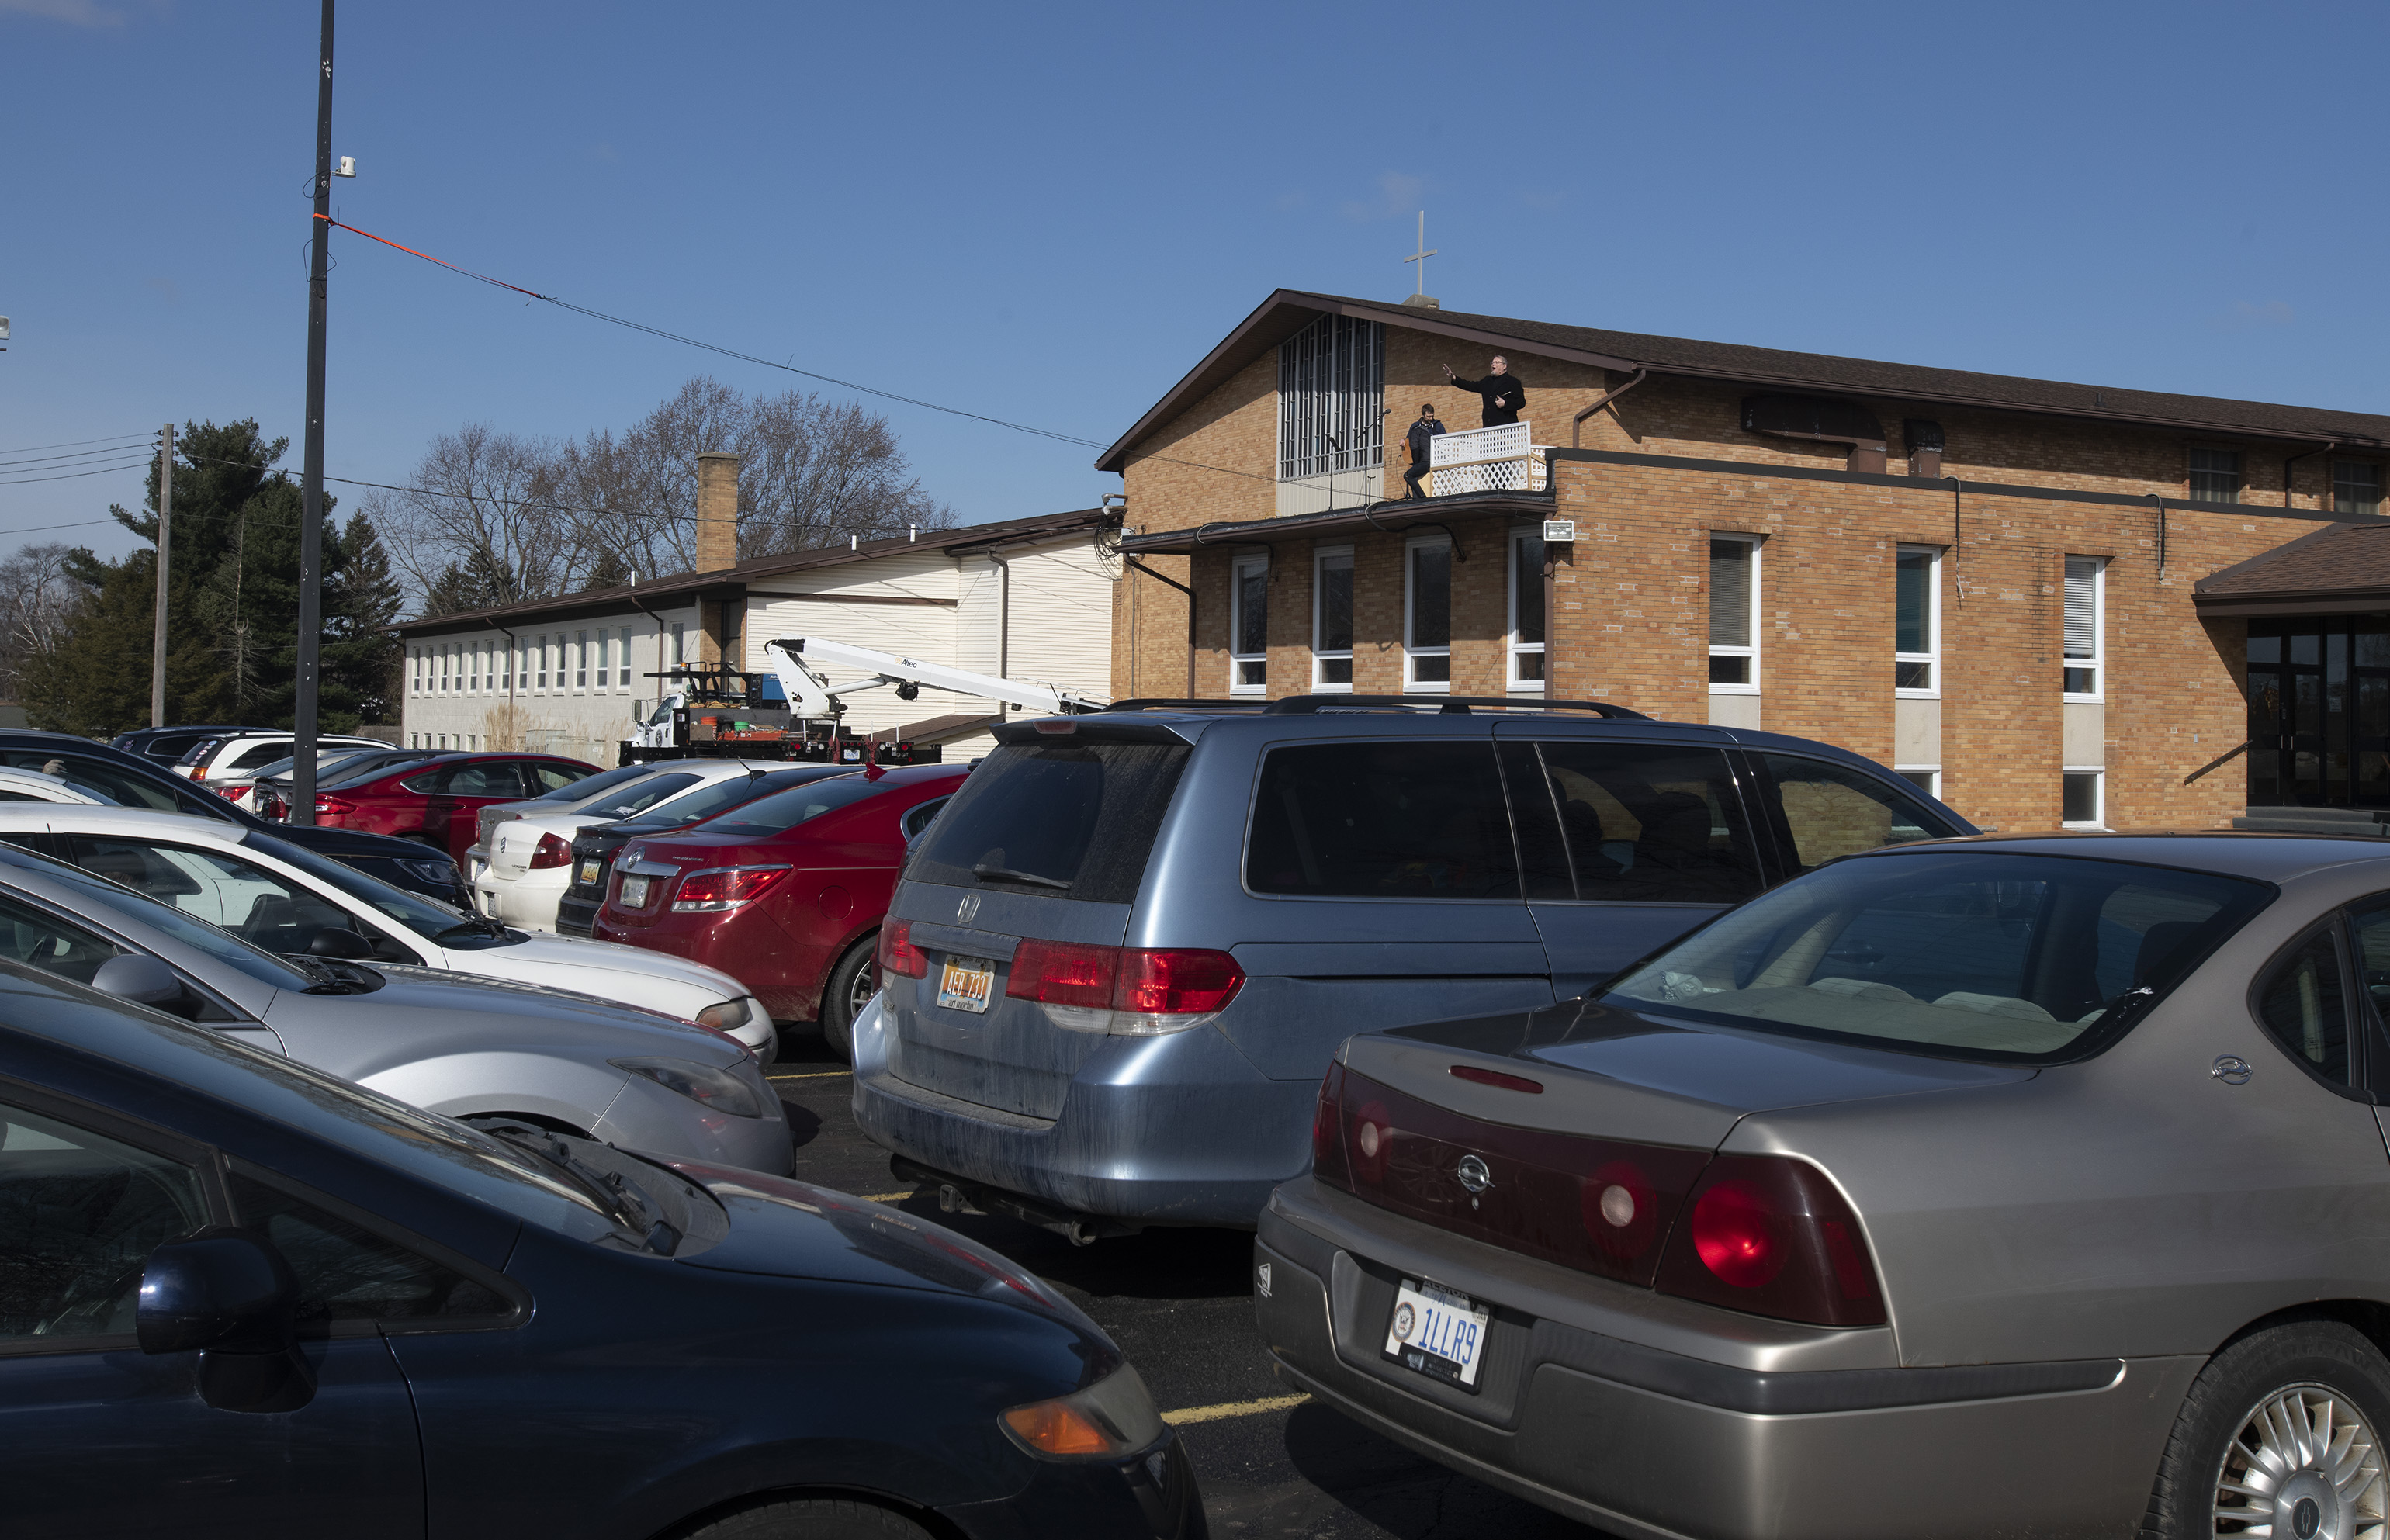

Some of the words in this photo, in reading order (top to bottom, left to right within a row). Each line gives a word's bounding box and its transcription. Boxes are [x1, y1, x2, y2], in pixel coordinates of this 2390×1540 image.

[901, 659, 917, 668] Altec
[947, 971, 965, 996] AEB
[967, 974, 985, 999] 733
[956, 1001, 974, 1010] moehn
[1418, 1308, 1477, 1365] 1LLR9
